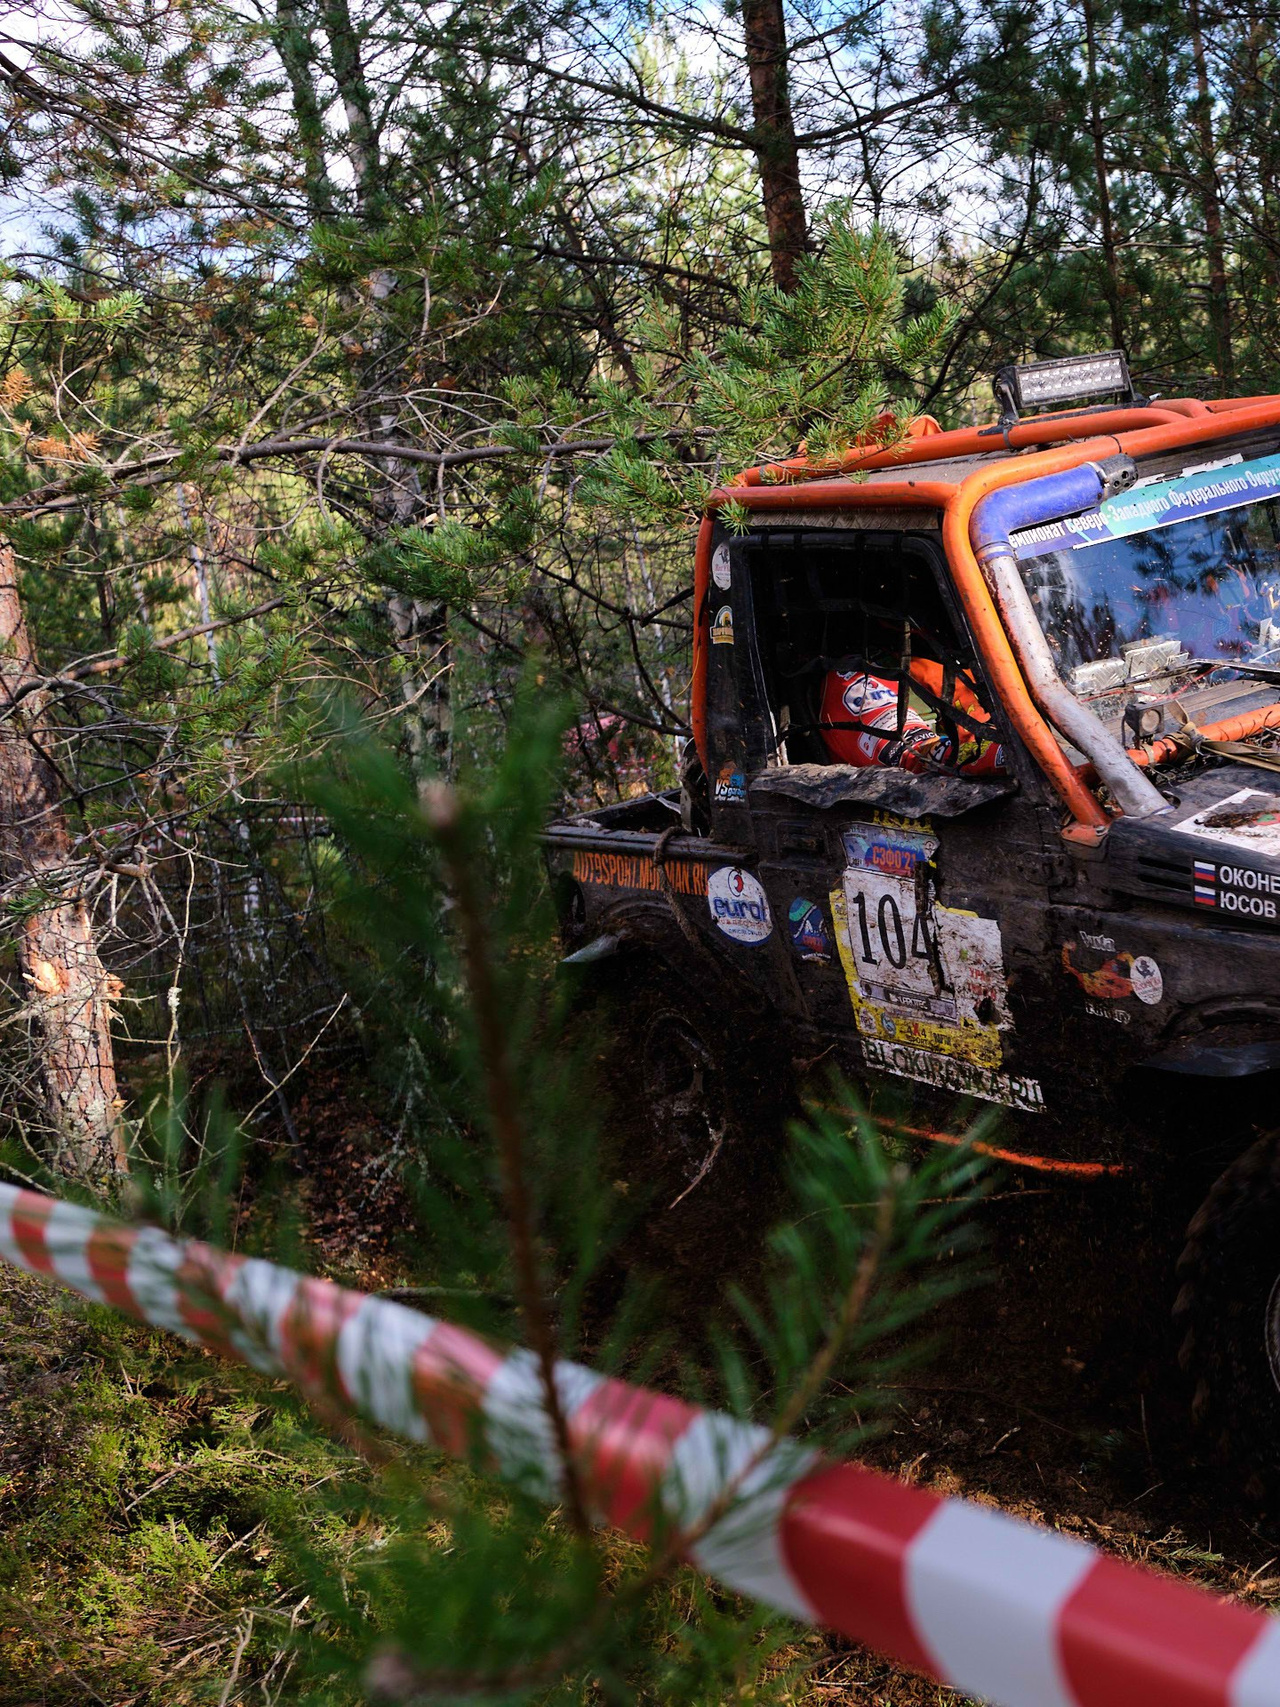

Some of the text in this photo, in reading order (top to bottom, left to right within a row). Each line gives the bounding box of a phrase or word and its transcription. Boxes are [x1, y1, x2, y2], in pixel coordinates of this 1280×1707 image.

[1008, 521, 1066, 549] емпионат
[1064, 496, 1170, 534] Северо-Западного
[1168, 476, 1249, 507] Федерального
[713, 896, 768, 923] eurol
[1219, 890, 1277, 918] ЮСОВ
[853, 891, 932, 970] 104
